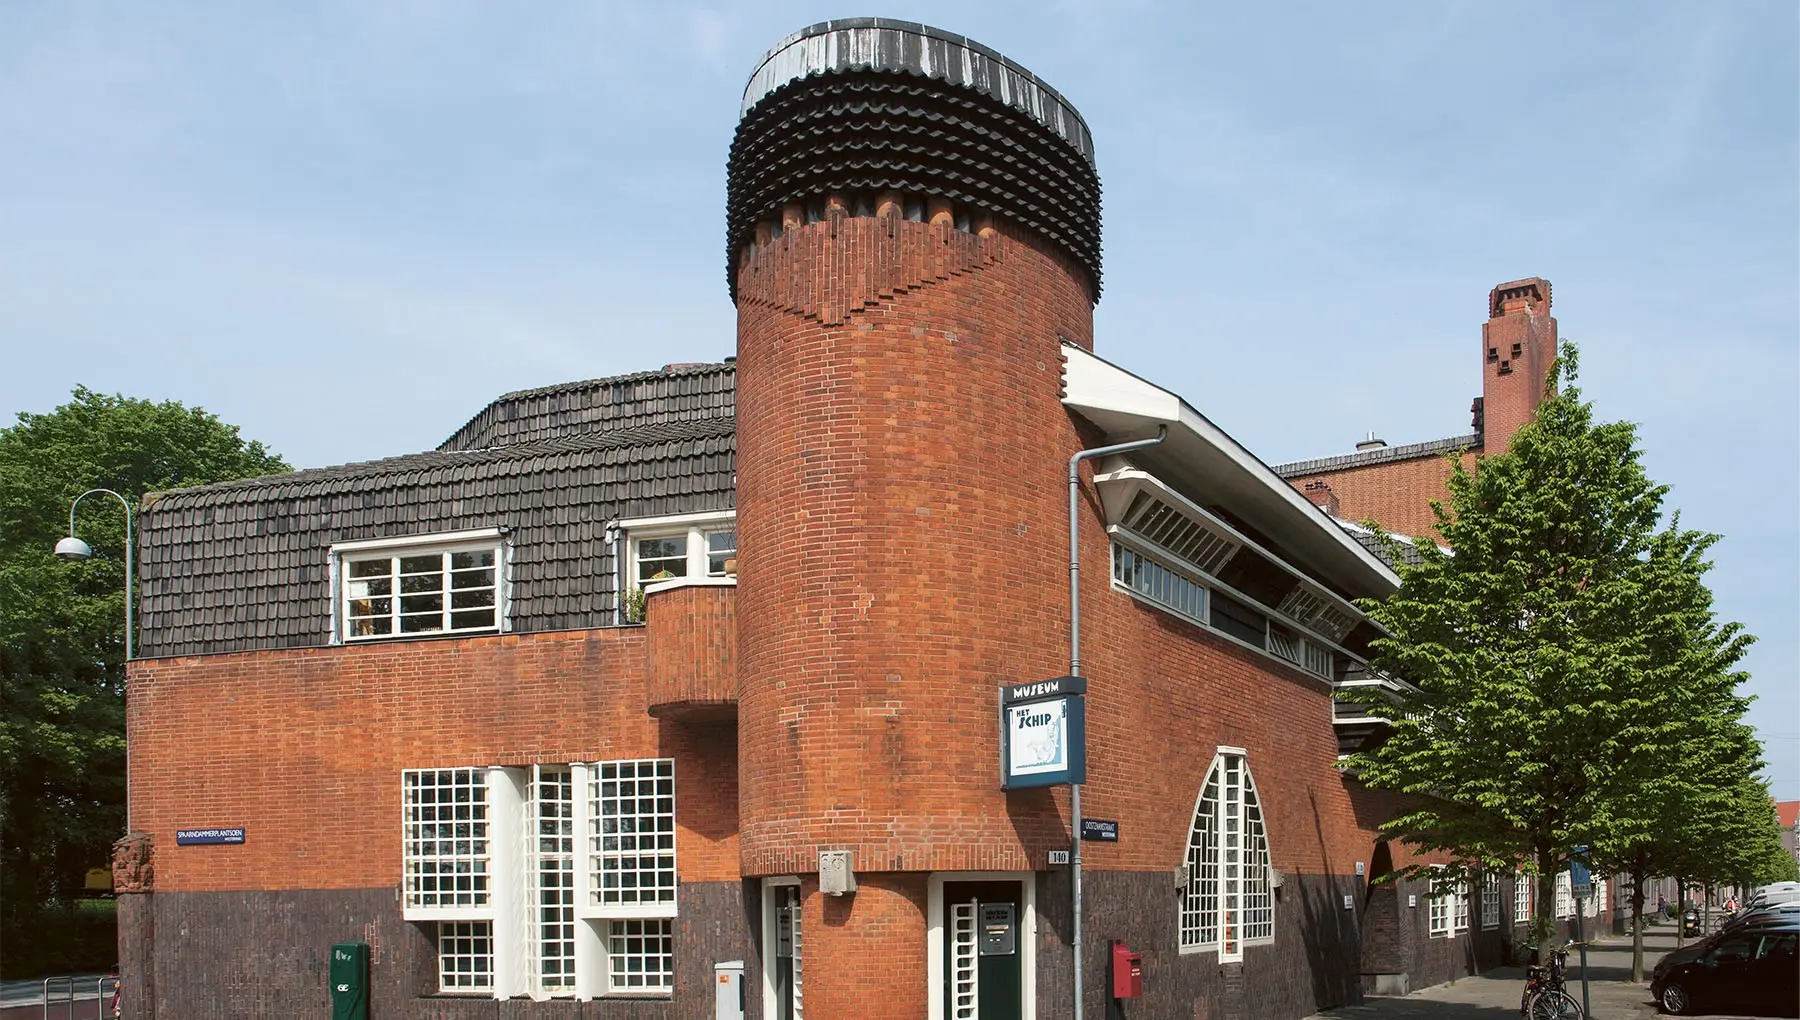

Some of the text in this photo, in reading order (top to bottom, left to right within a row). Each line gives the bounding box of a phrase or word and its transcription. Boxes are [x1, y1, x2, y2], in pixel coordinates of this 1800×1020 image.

[1013, 681, 1059, 699] MUSEUM
[1016, 709, 1030, 718] HET
[1018, 713, 1052, 729] SCHIP
[1053, 852, 1066, 863] 140
